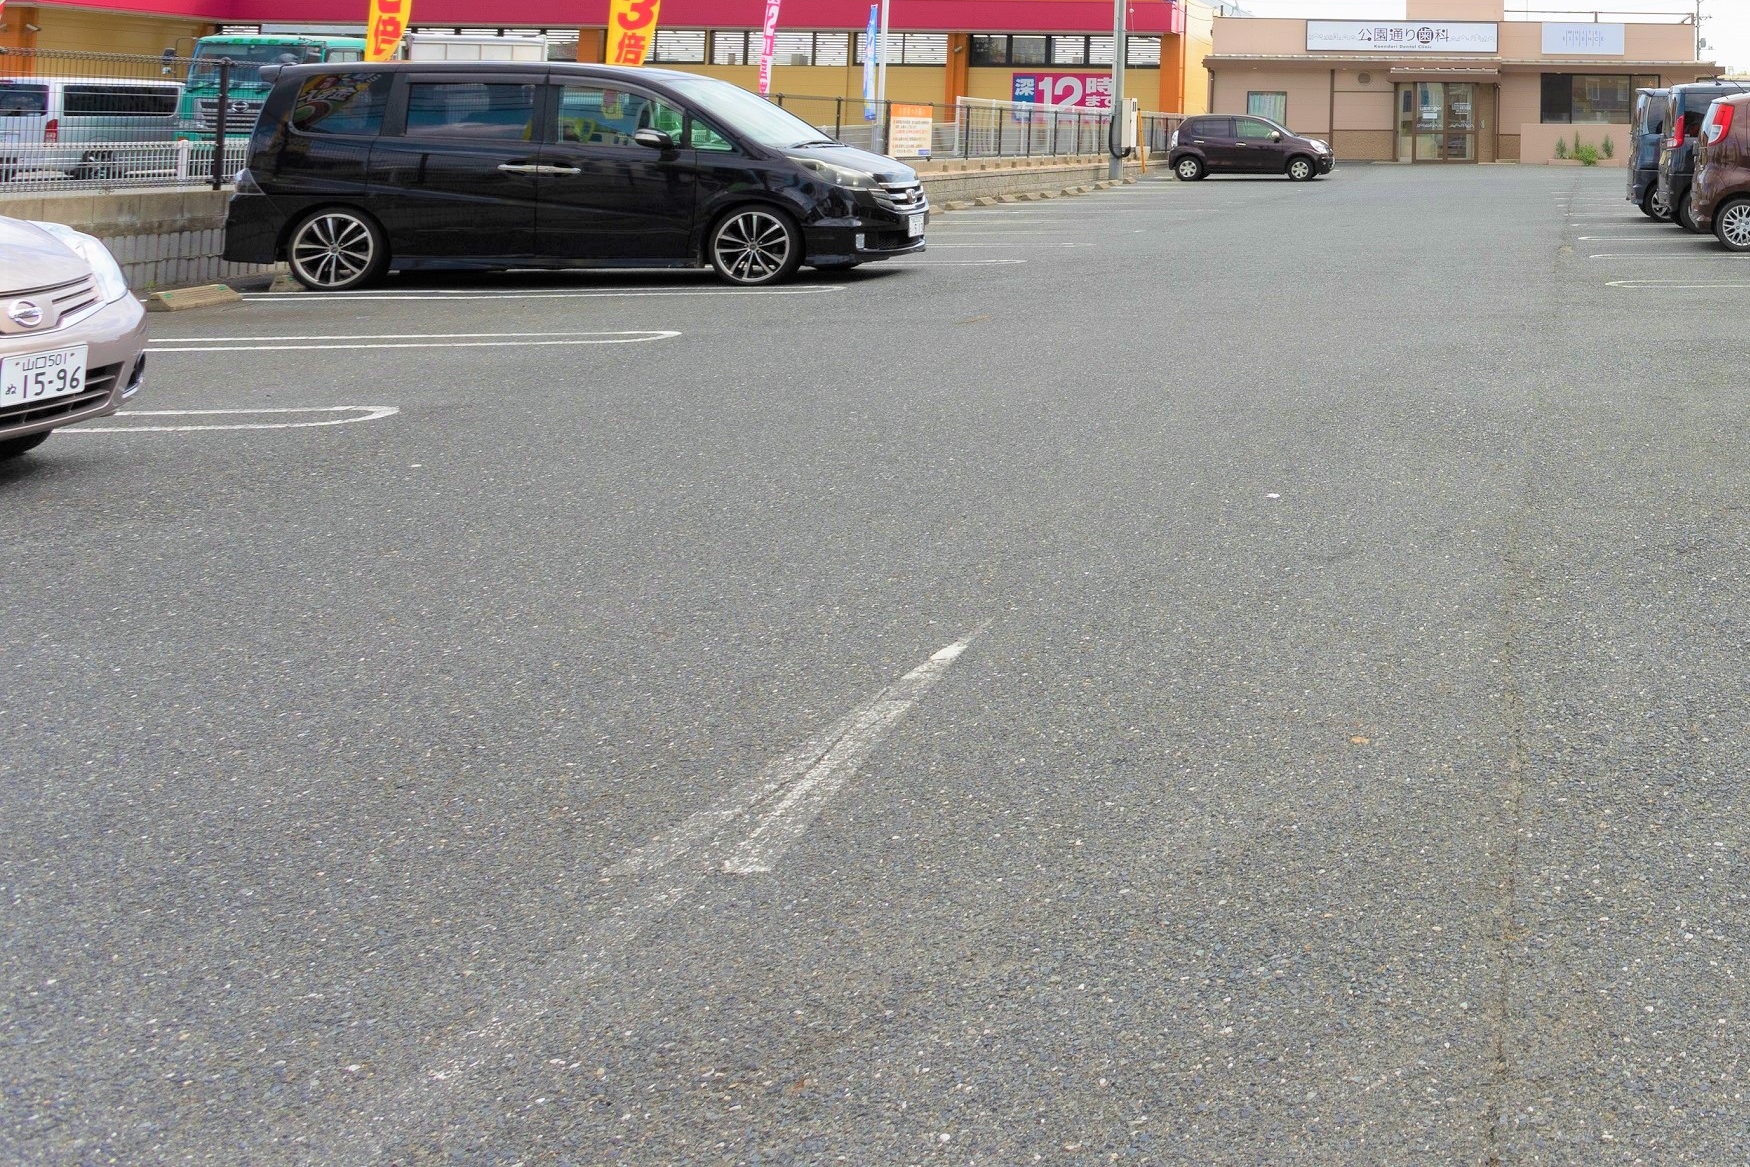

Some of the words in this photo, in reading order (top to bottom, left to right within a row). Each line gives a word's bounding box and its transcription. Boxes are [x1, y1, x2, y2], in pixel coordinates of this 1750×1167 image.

[1358, 27, 1449, 44] 公園通り歯科
[1038, 76, 1083, 121] 12
[23, 366, 81, 399] 15-96
